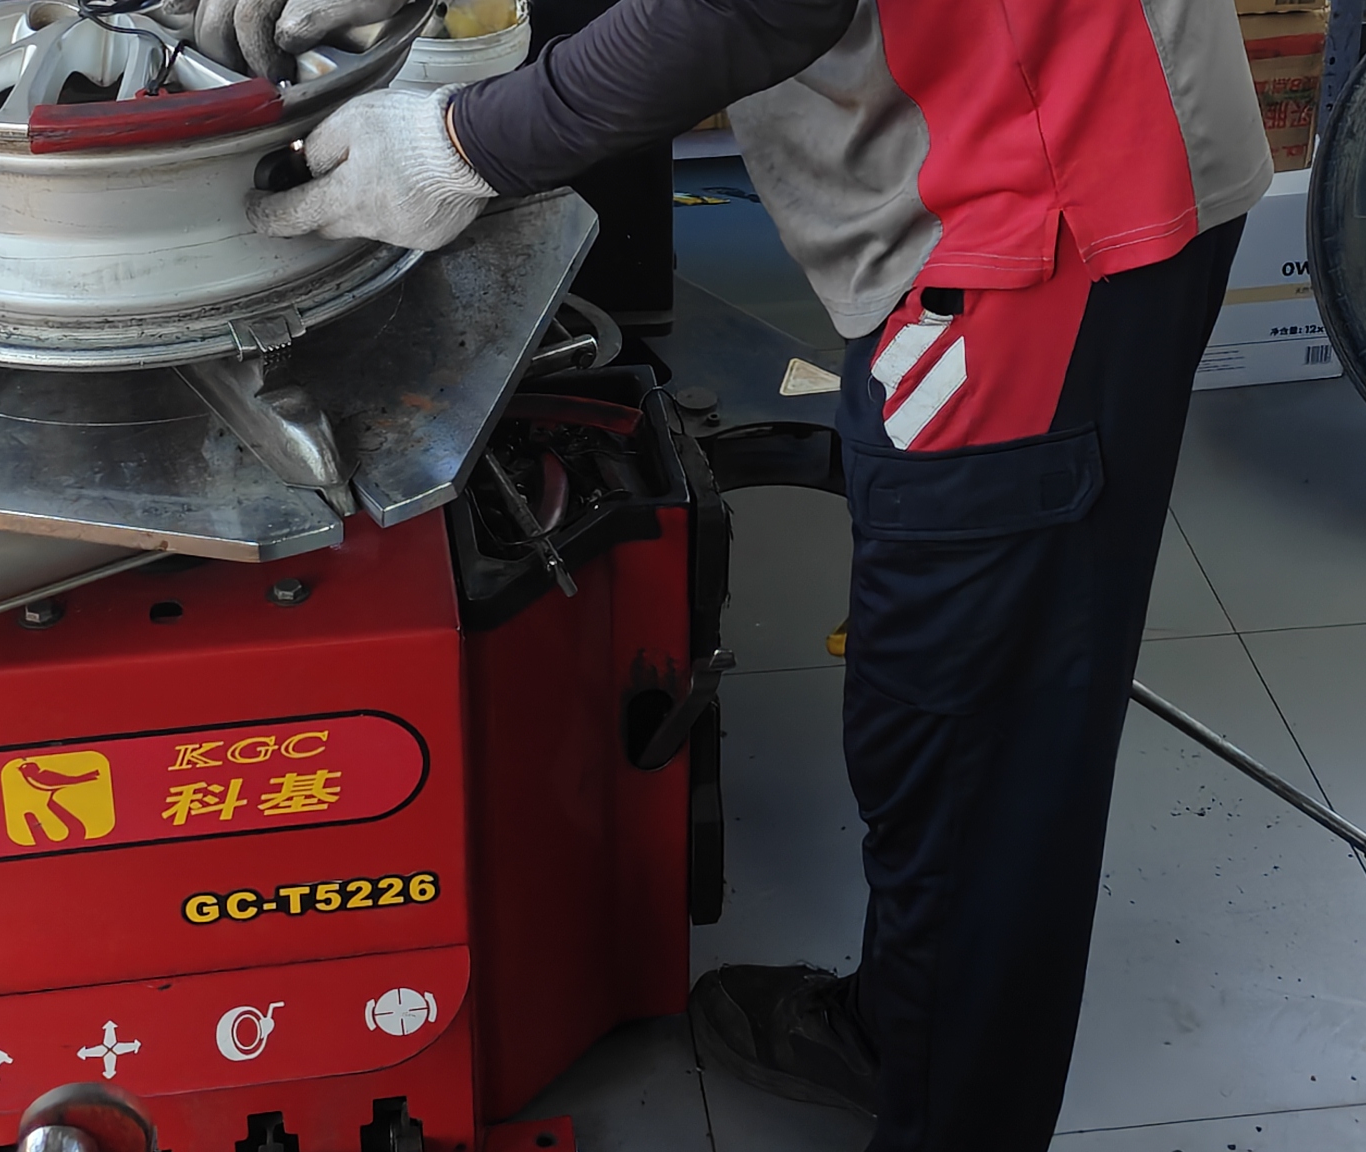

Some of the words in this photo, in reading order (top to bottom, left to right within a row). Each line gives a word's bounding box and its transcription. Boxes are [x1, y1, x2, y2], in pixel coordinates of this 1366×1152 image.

[168, 730, 329, 770] KGC
[161, 770, 342, 826] 科基
[185, 874, 436, 923] GC-T5226
